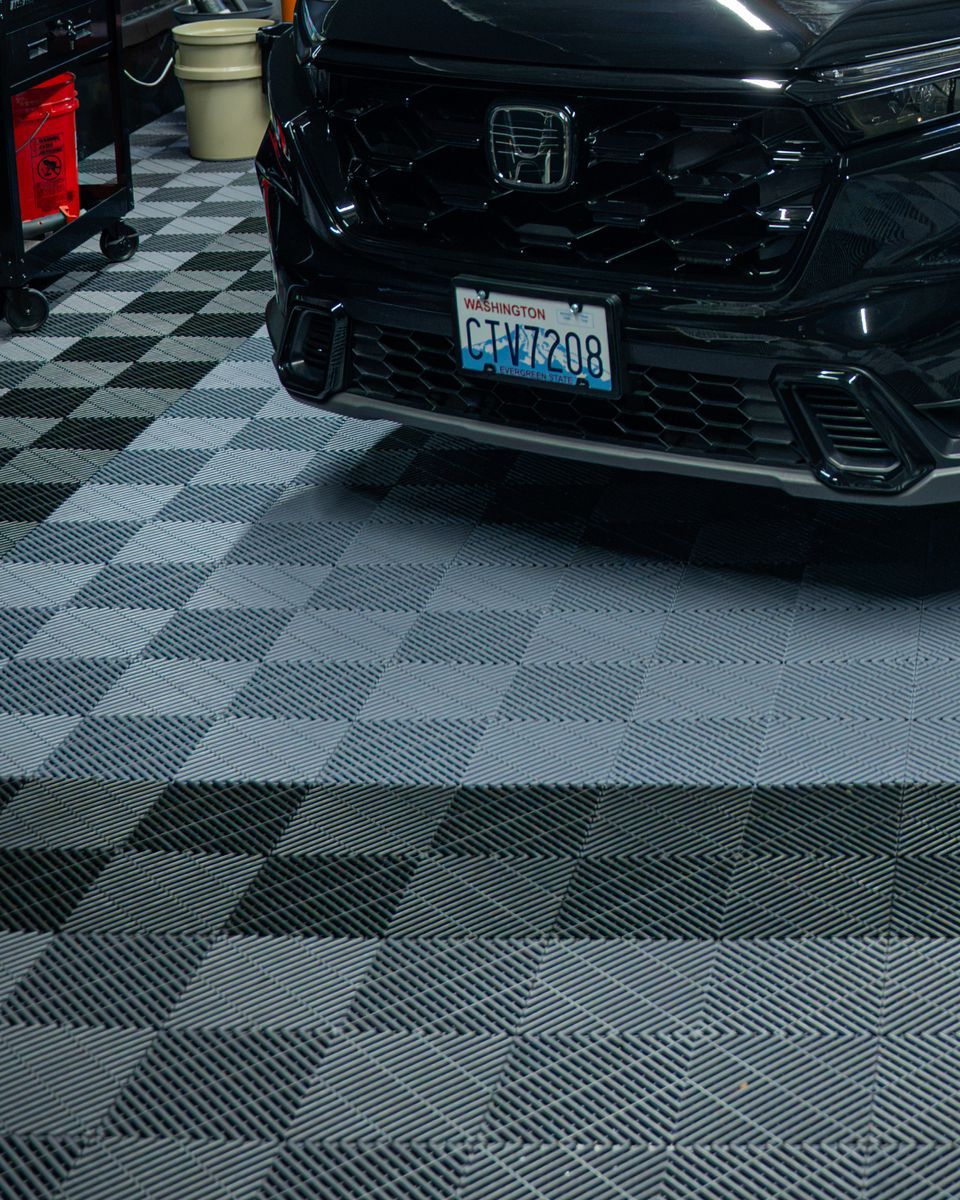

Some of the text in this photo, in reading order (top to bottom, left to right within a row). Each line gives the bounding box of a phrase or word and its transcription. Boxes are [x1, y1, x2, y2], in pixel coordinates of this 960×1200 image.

[464, 298, 546, 320] WASHINGTON
[466, 317, 604, 379] CTV7208
[500, 366, 573, 385] EVERGREEN STATE
